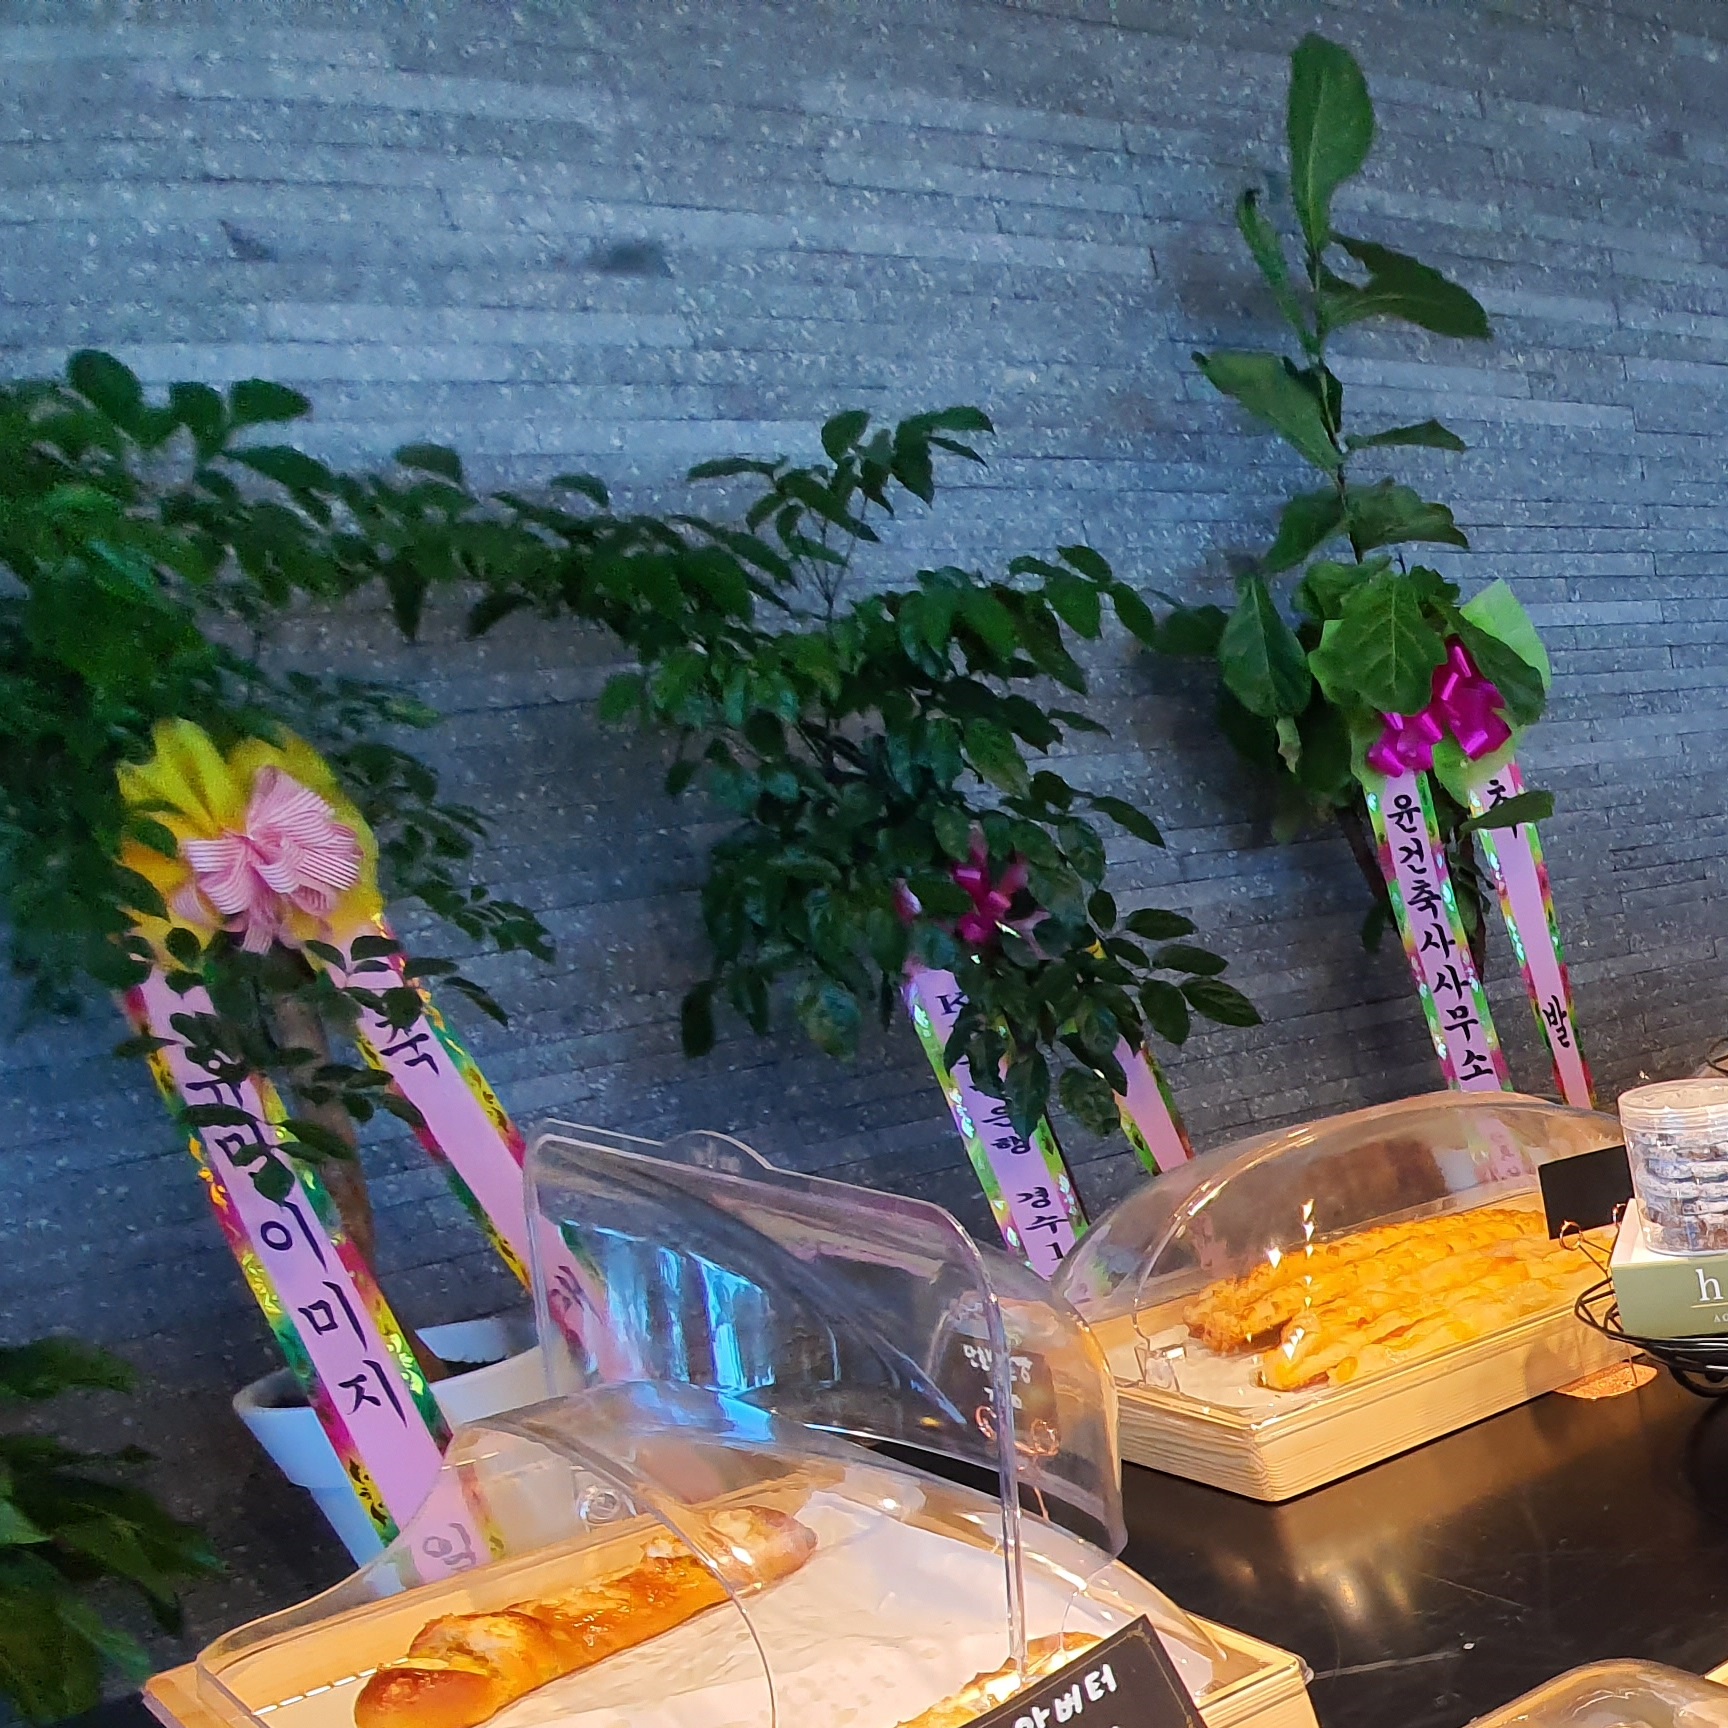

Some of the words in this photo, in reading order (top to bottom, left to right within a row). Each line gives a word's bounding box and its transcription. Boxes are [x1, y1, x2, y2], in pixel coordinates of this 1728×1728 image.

[1387, 794, 1494, 1082] 윤건축사사무소
[1543, 995, 1570, 1048] 발
[1713, 1313, 1721, 1323] A
